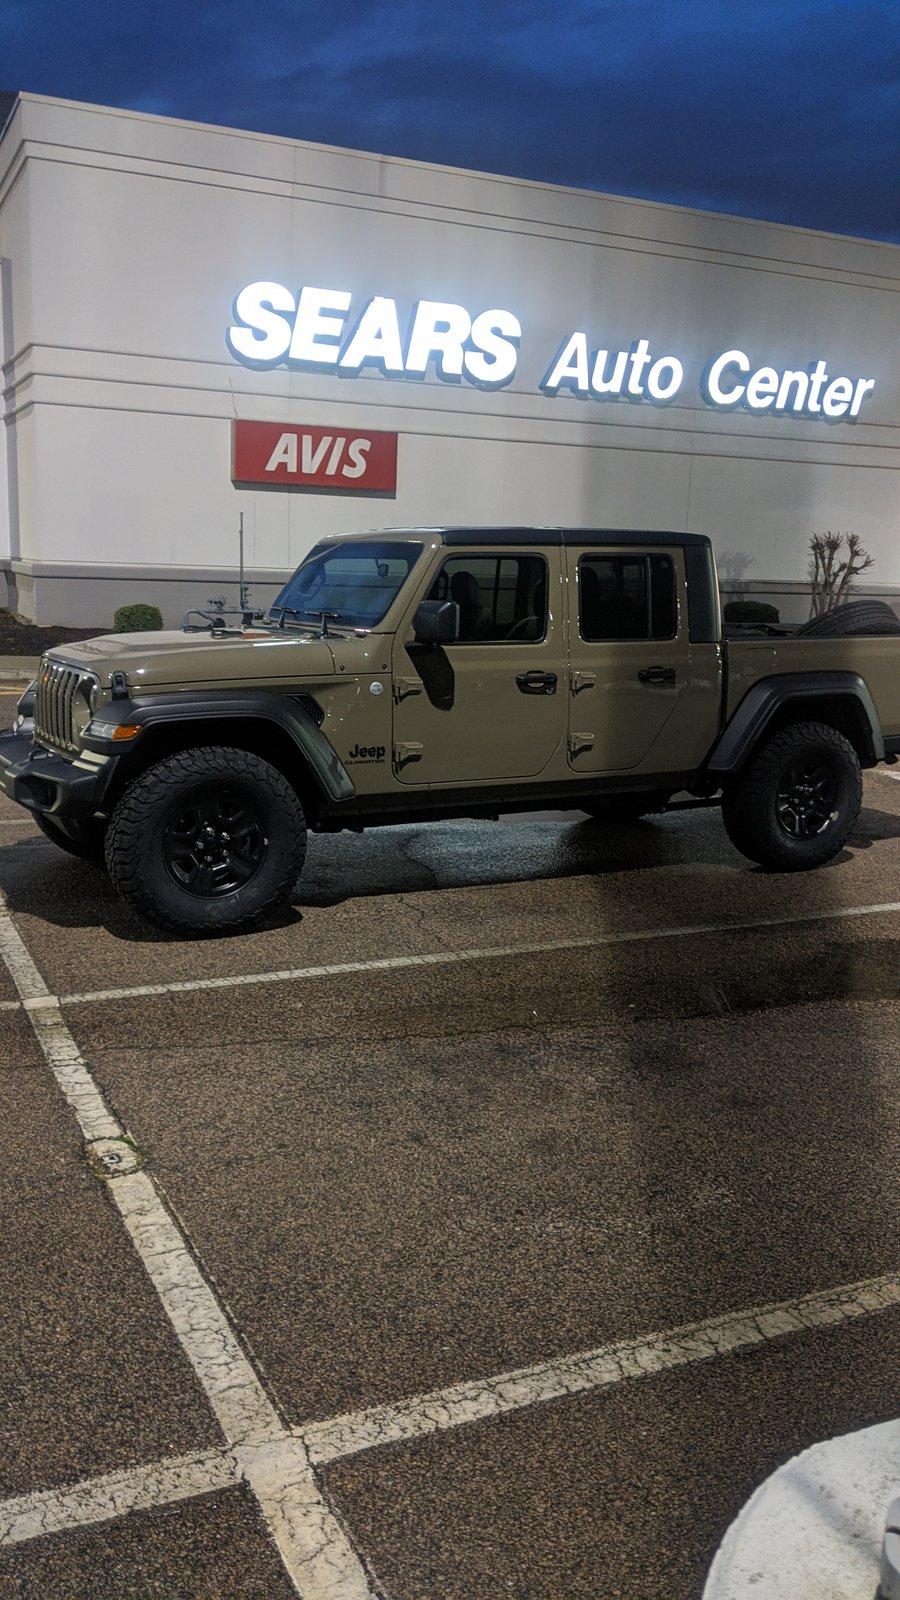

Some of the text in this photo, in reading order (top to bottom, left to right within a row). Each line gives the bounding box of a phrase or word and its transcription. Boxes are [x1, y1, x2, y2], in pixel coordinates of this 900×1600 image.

[227, 281, 875, 420] SEARS Auto Center
[265, 432, 371, 479] AVIS
[349, 744, 385, 759] Jeep
